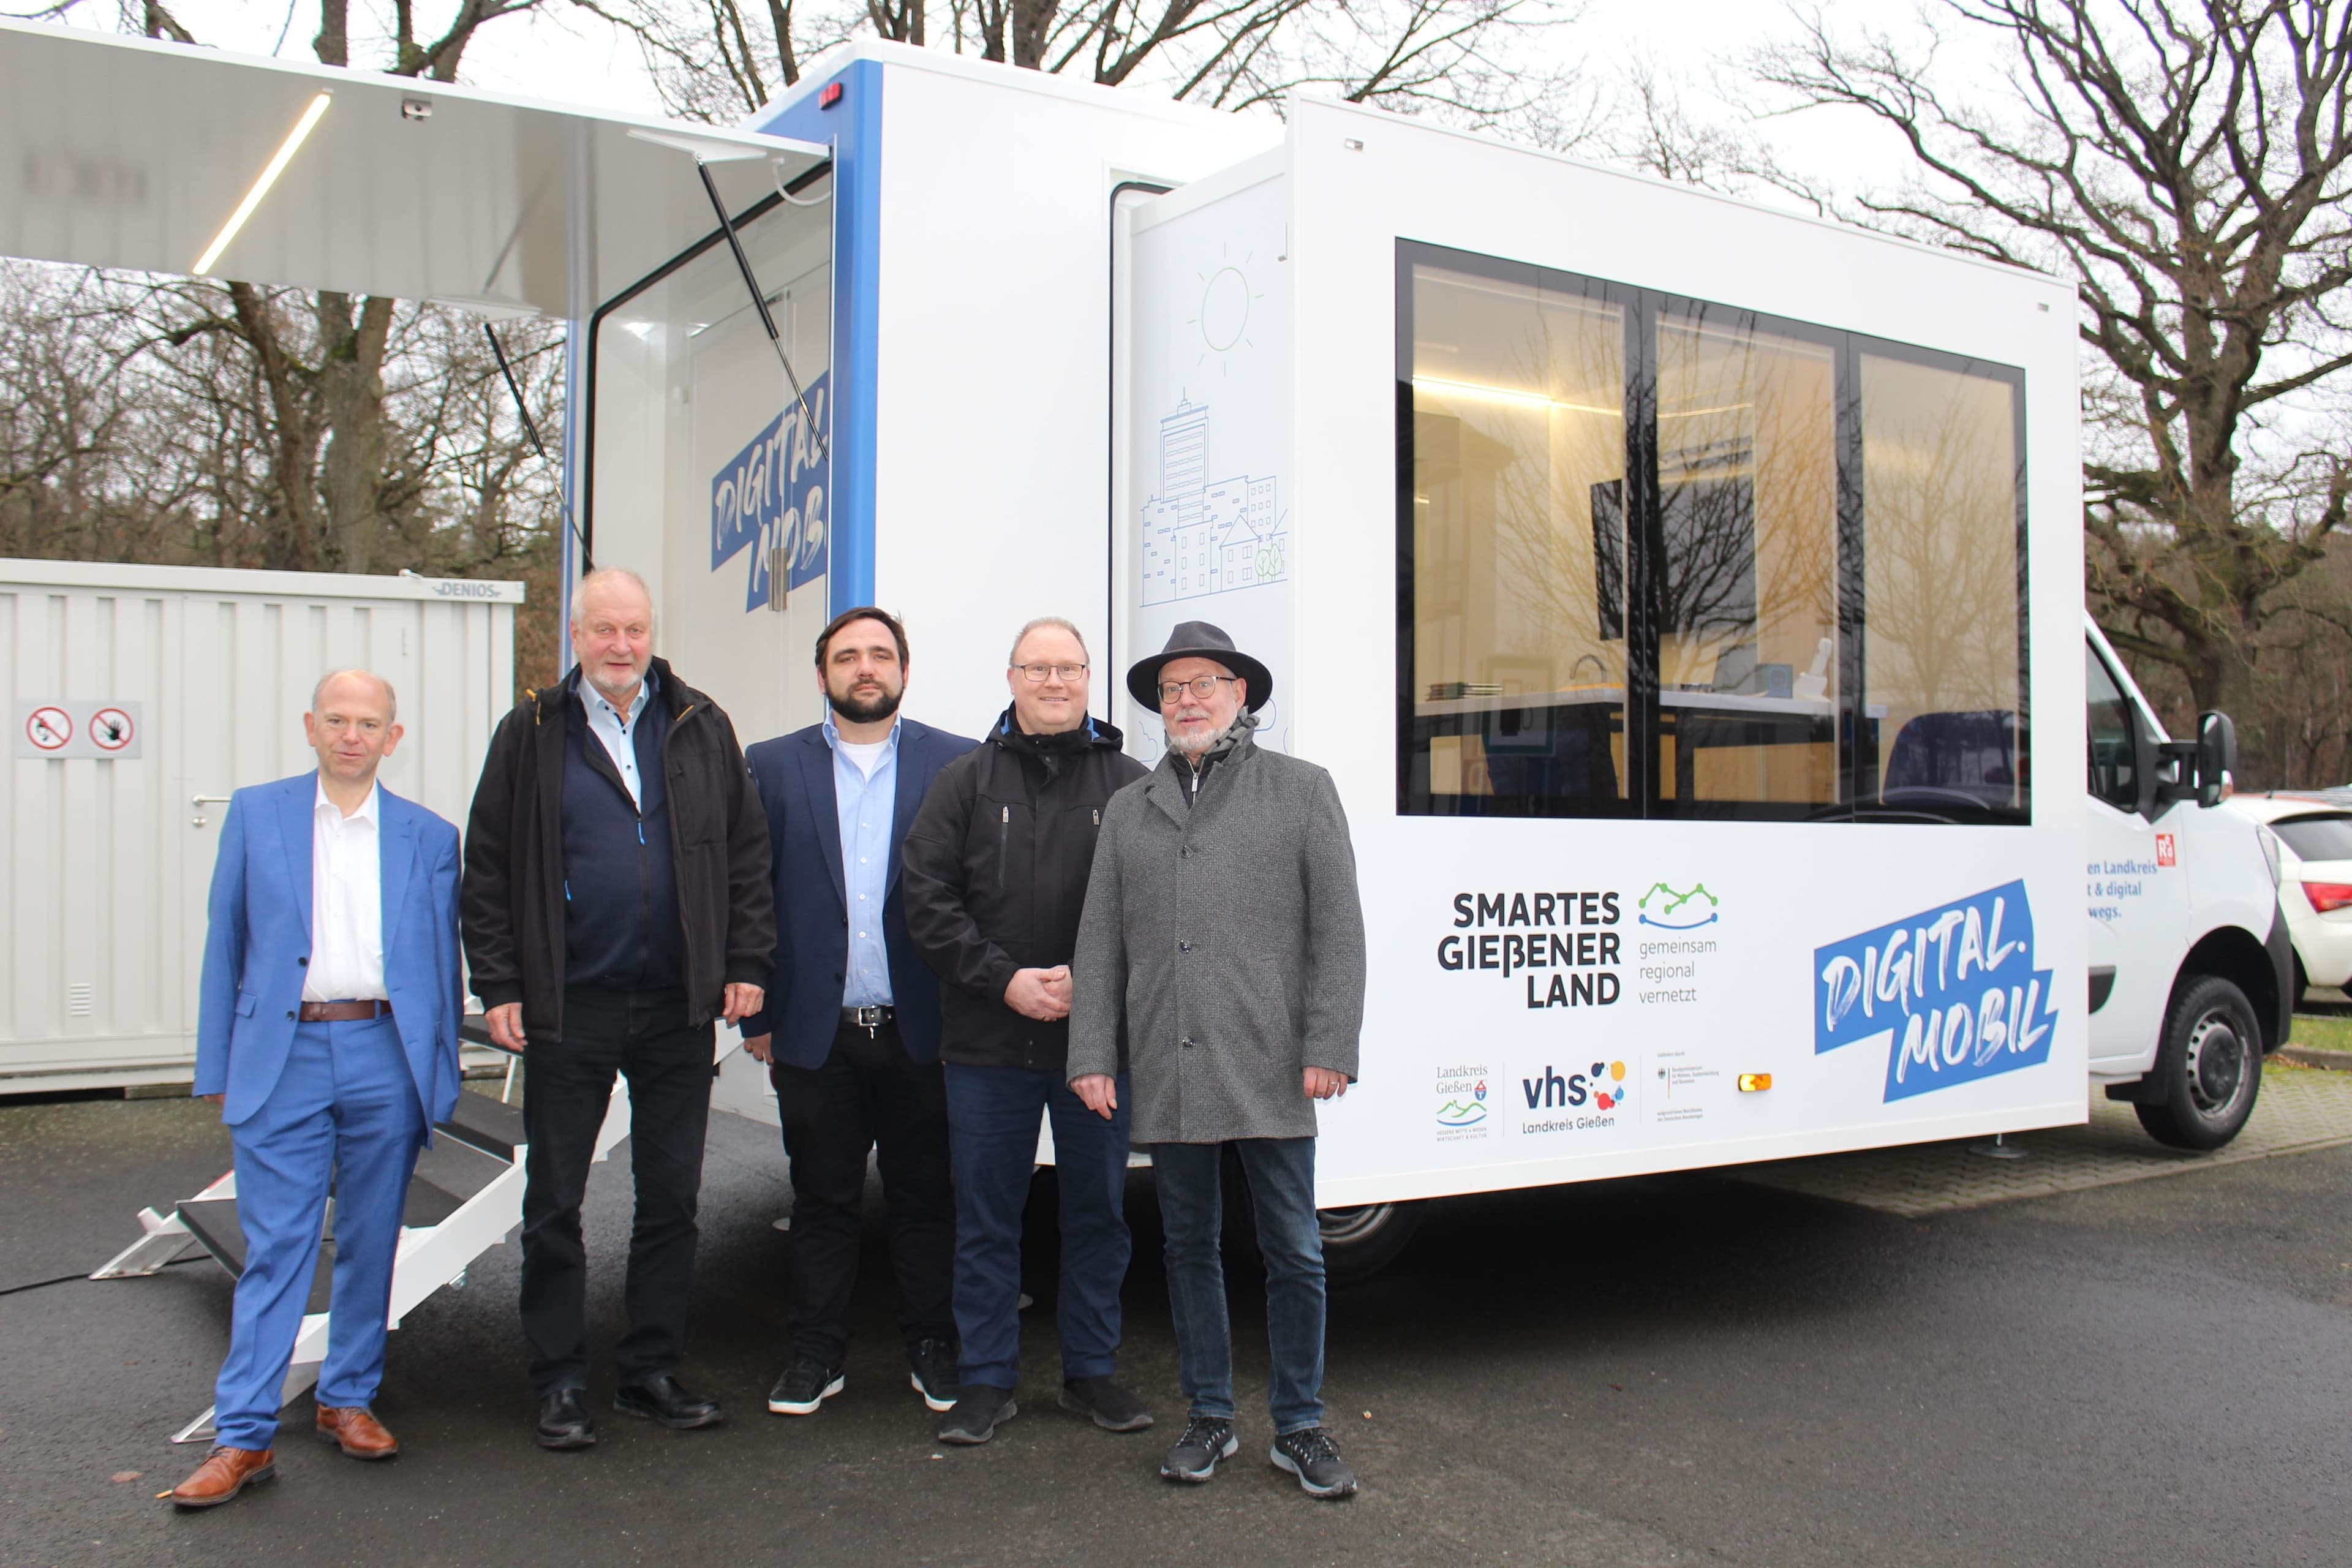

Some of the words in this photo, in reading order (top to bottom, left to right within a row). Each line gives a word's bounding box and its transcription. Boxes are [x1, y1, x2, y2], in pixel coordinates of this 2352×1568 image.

[715, 388, 827, 550] DIGITAL
[753, 486, 826, 592] MOB
[441, 582, 495, 597] DENIOS
[2087, 862, 2100, 875] en
[2105, 859, 2157, 875] Landkreis
[2095, 883, 2102, 896] &
[2107, 881, 2141, 899] digital
[1453, 892, 1620, 927] SMARTES
[2087, 907, 2122, 921] wegs.
[1438, 932, 1621, 978] GIEßENER
[1640, 936, 1716, 959] gemeinsam
[1640, 960, 1694, 984] regional
[1822, 896, 2026, 1032] DIGITAL.
[1528, 973, 1620, 1008] LAND
[1639, 988, 1697, 1003] vernetzt
[1896, 979, 2049, 1084] MOBIL
[1437, 1064, 1488, 1078] Landkreis
[1436, 1080, 1472, 1094] Gießen
[1523, 1066, 1587, 1109] vhs
[1523, 1119, 1573, 1134] Landkreis
[1577, 1116, 1615, 1129] Gießen
